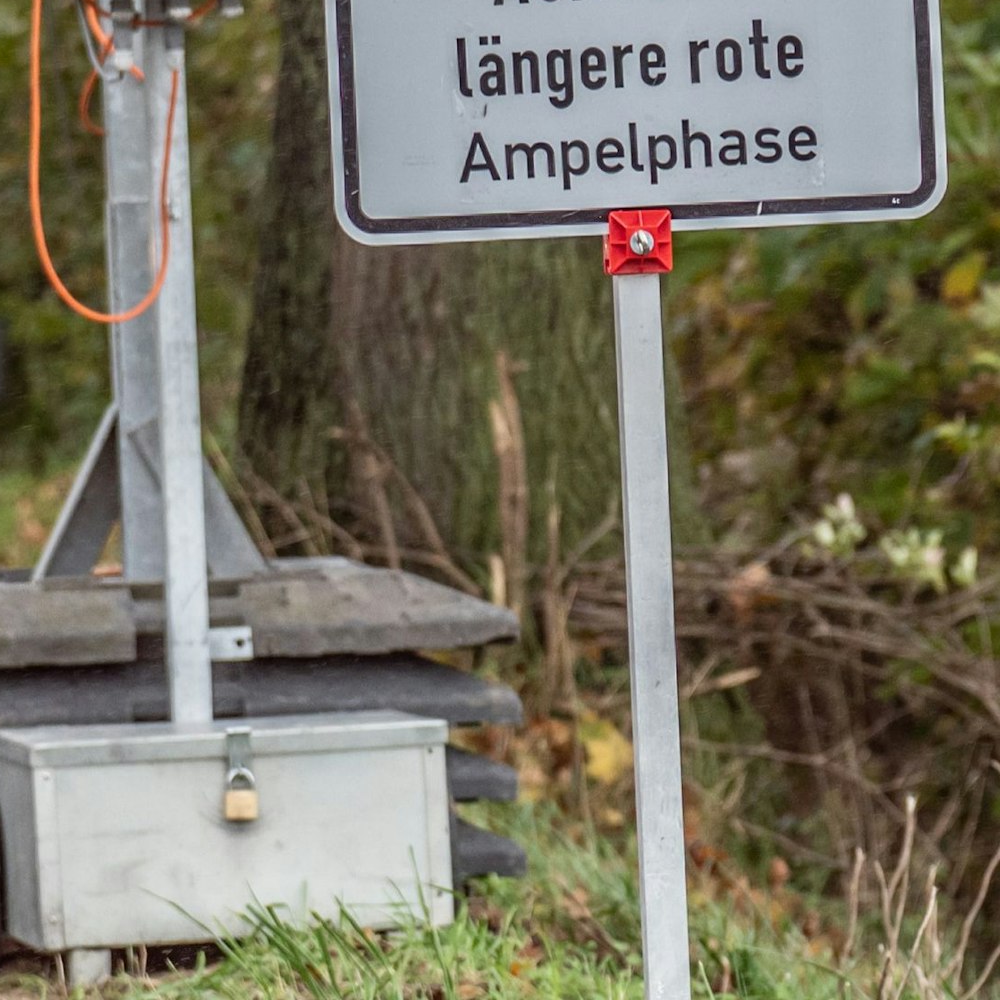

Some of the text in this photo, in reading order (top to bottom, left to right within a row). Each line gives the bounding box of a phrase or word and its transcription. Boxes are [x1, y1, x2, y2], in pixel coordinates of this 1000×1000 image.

[455, 18, 804, 110] längere rote
[459, 118, 818, 191] Ampelphase
